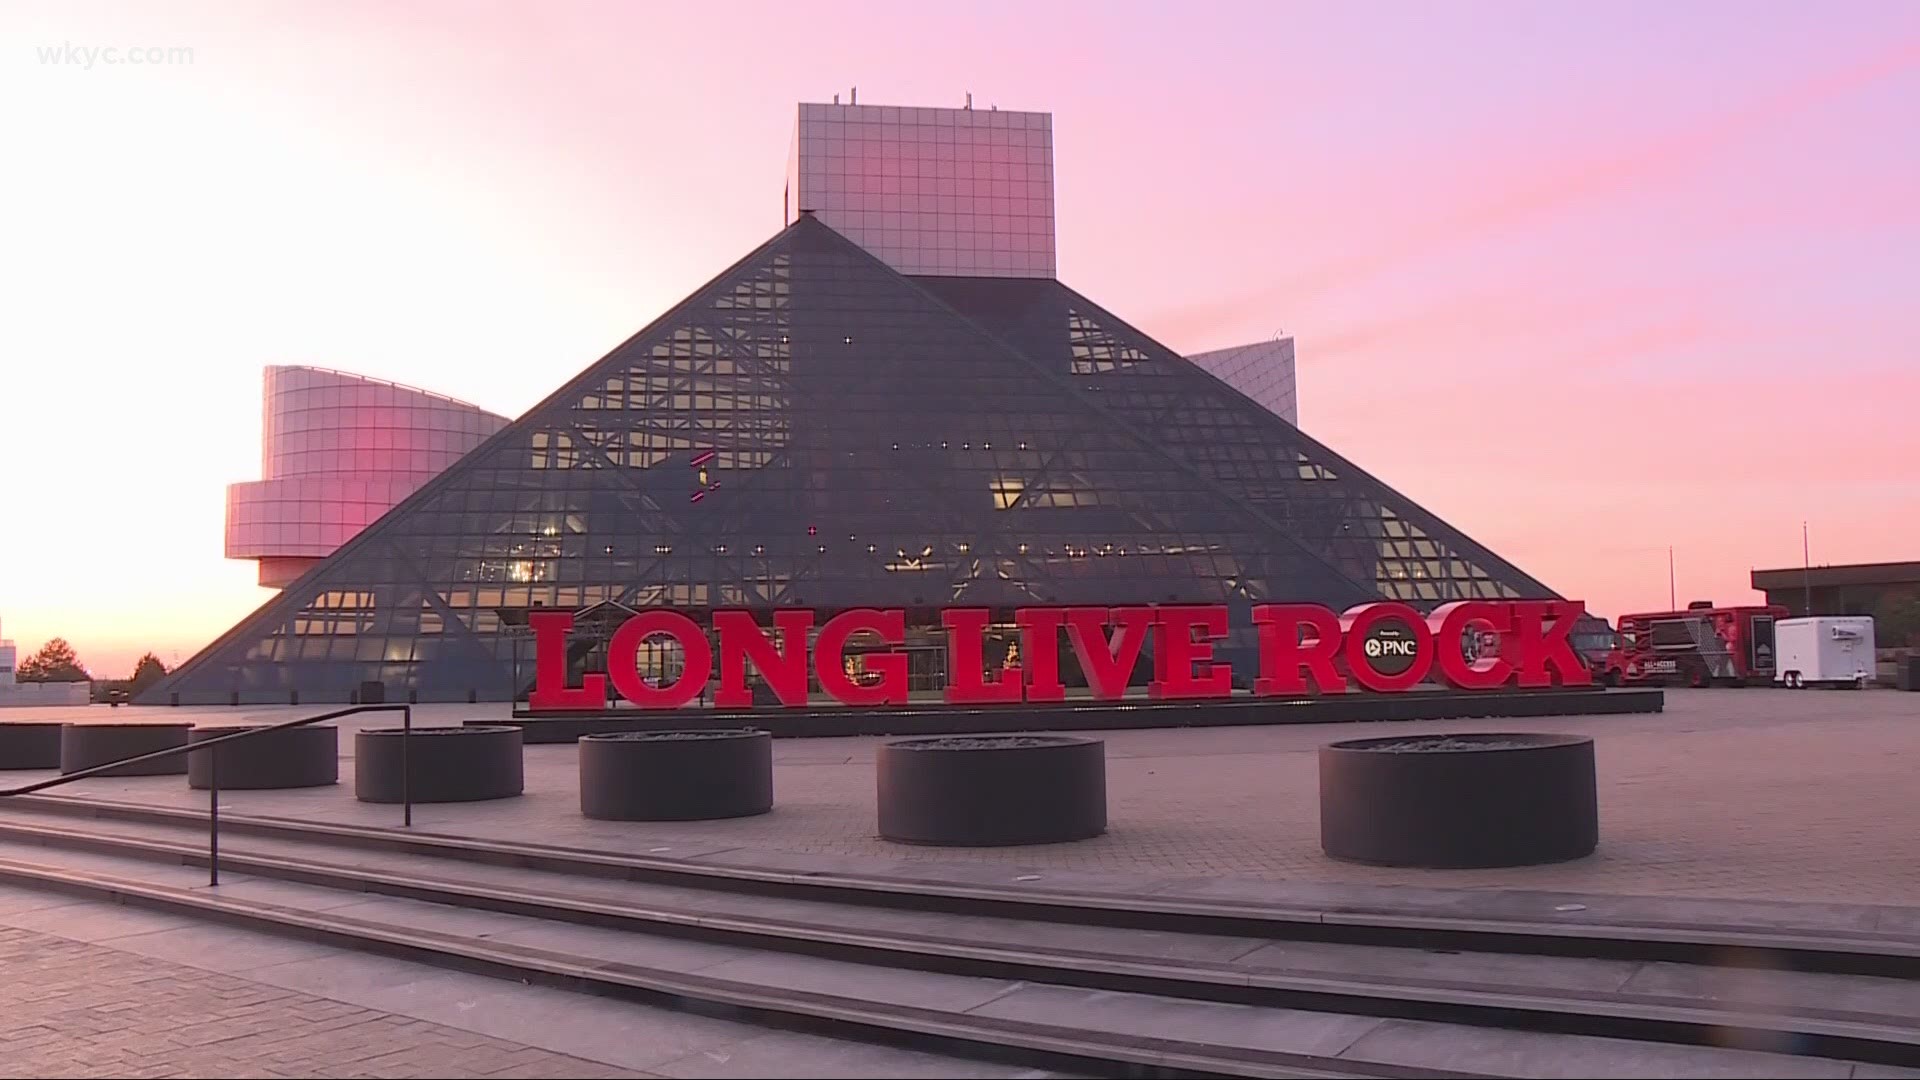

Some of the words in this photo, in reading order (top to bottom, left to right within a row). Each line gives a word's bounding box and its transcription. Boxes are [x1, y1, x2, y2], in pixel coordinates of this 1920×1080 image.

[528, 608, 909, 710] LONG
[942, 605, 1232, 702] LIVE
[1252, 600, 1593, 695] ROCK
[1382, 640, 1416, 655] PNC
